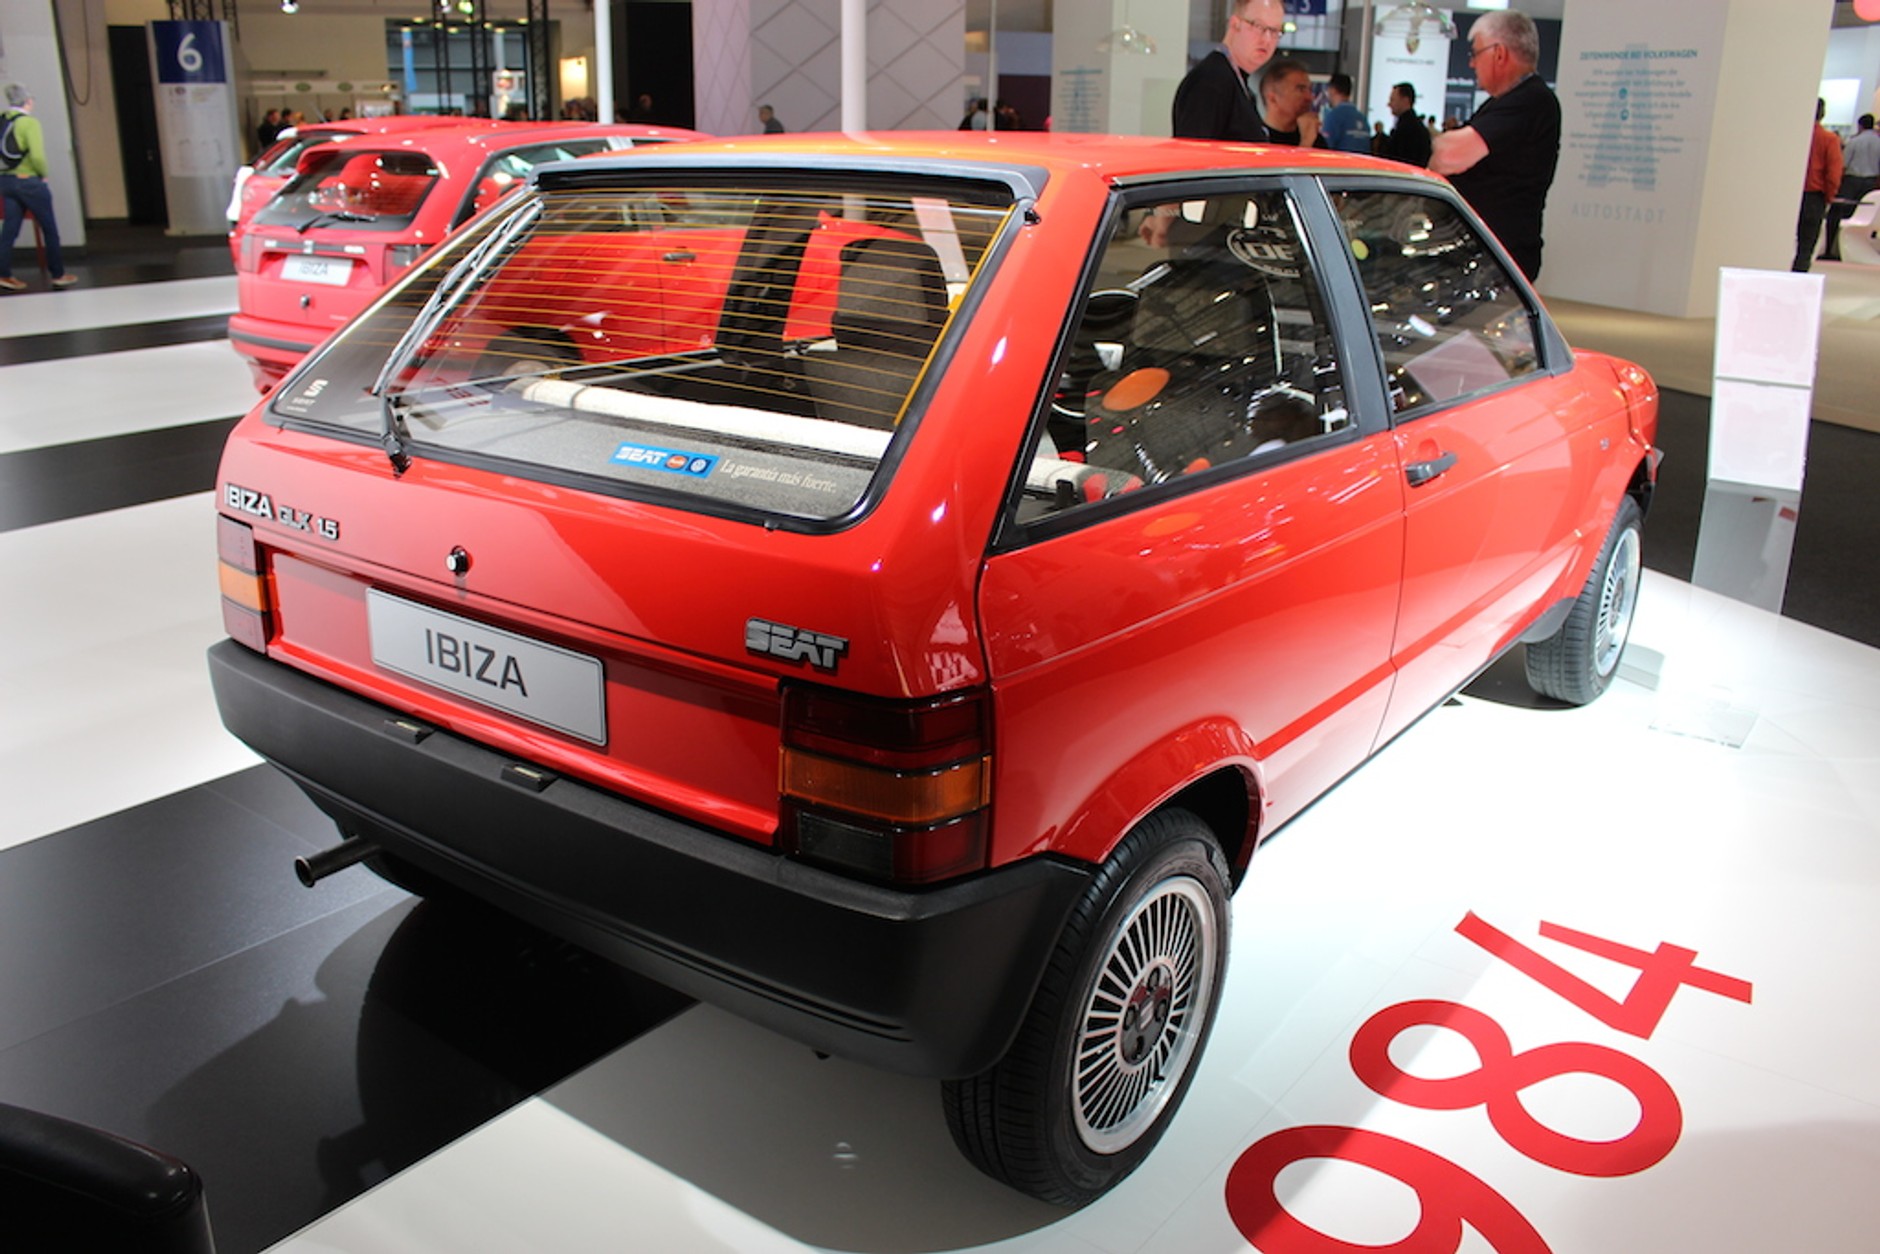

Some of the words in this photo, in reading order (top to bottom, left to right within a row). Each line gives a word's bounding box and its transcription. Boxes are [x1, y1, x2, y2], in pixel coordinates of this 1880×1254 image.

[177, 33, 203, 72] 6
[1644, 49, 1698, 59] VOLKSWAGEN
[1571, 203, 1665, 223] AUTOSTADT
[615, 447, 668, 465] SEAT
[720, 459, 736, 474] La
[224, 482, 276, 520] IBIZA
[278, 505, 313, 533] GLX
[745, 616, 849, 671] SEAT
[425, 628, 529, 698] IBIZA
